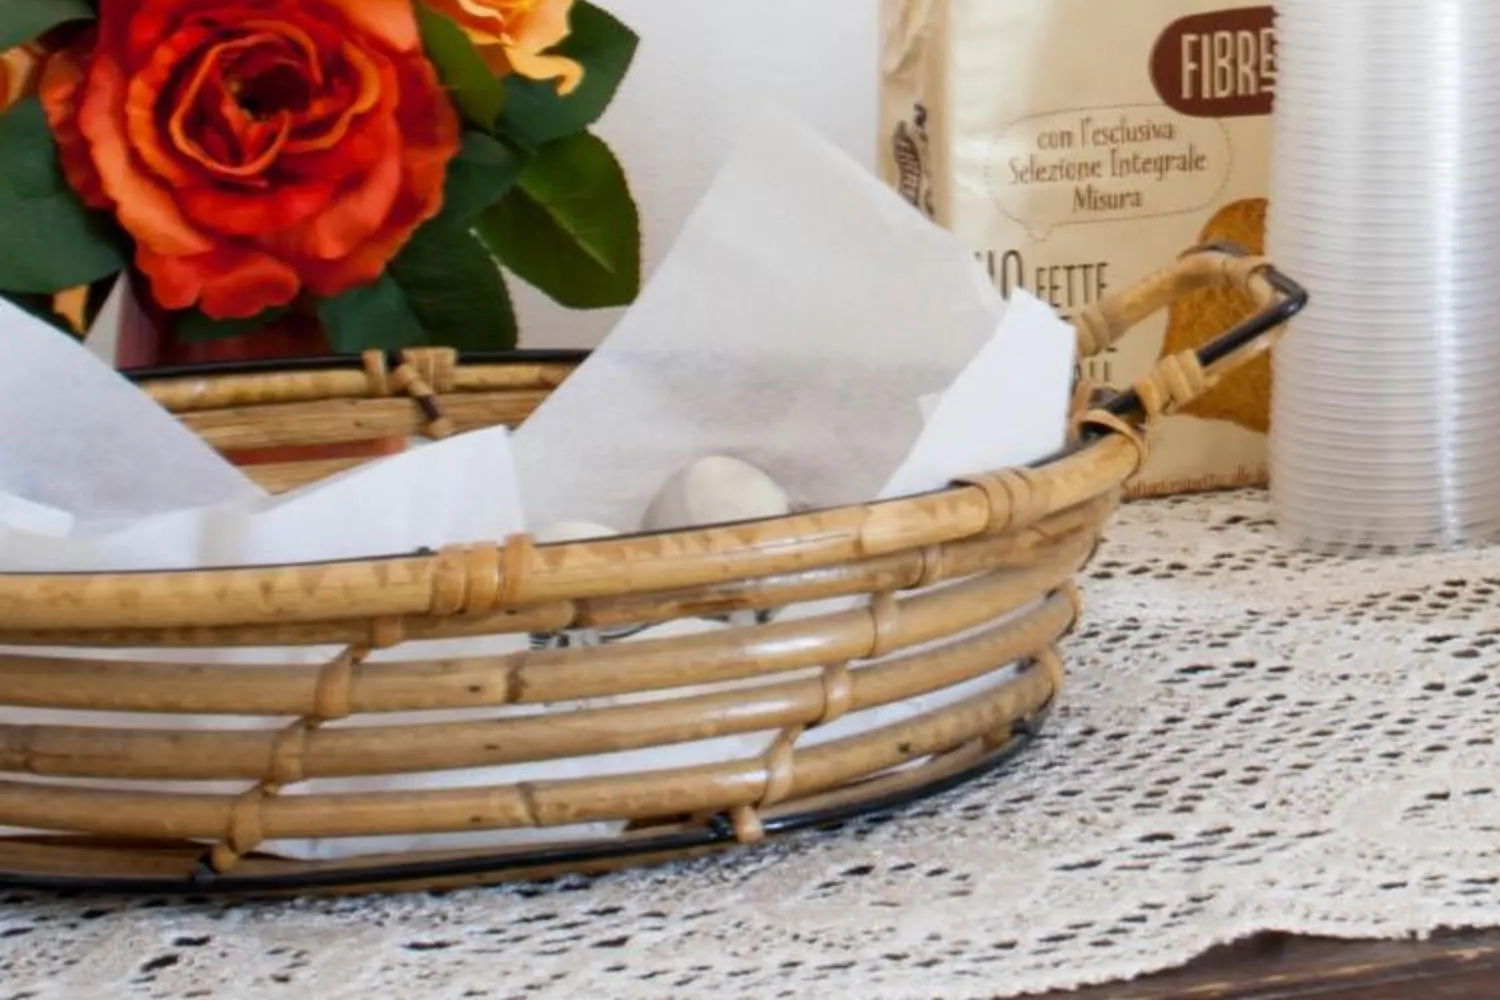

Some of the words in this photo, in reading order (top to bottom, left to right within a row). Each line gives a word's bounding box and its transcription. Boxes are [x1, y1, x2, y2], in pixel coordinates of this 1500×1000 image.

[1037, 128, 1073, 150] con
[1081, 117, 1176, 149] l'esclusiva
[1009, 153, 1101, 185] Selezione
[1110, 143, 1207, 181] Integrale
[1072, 184, 1143, 213] Misura
